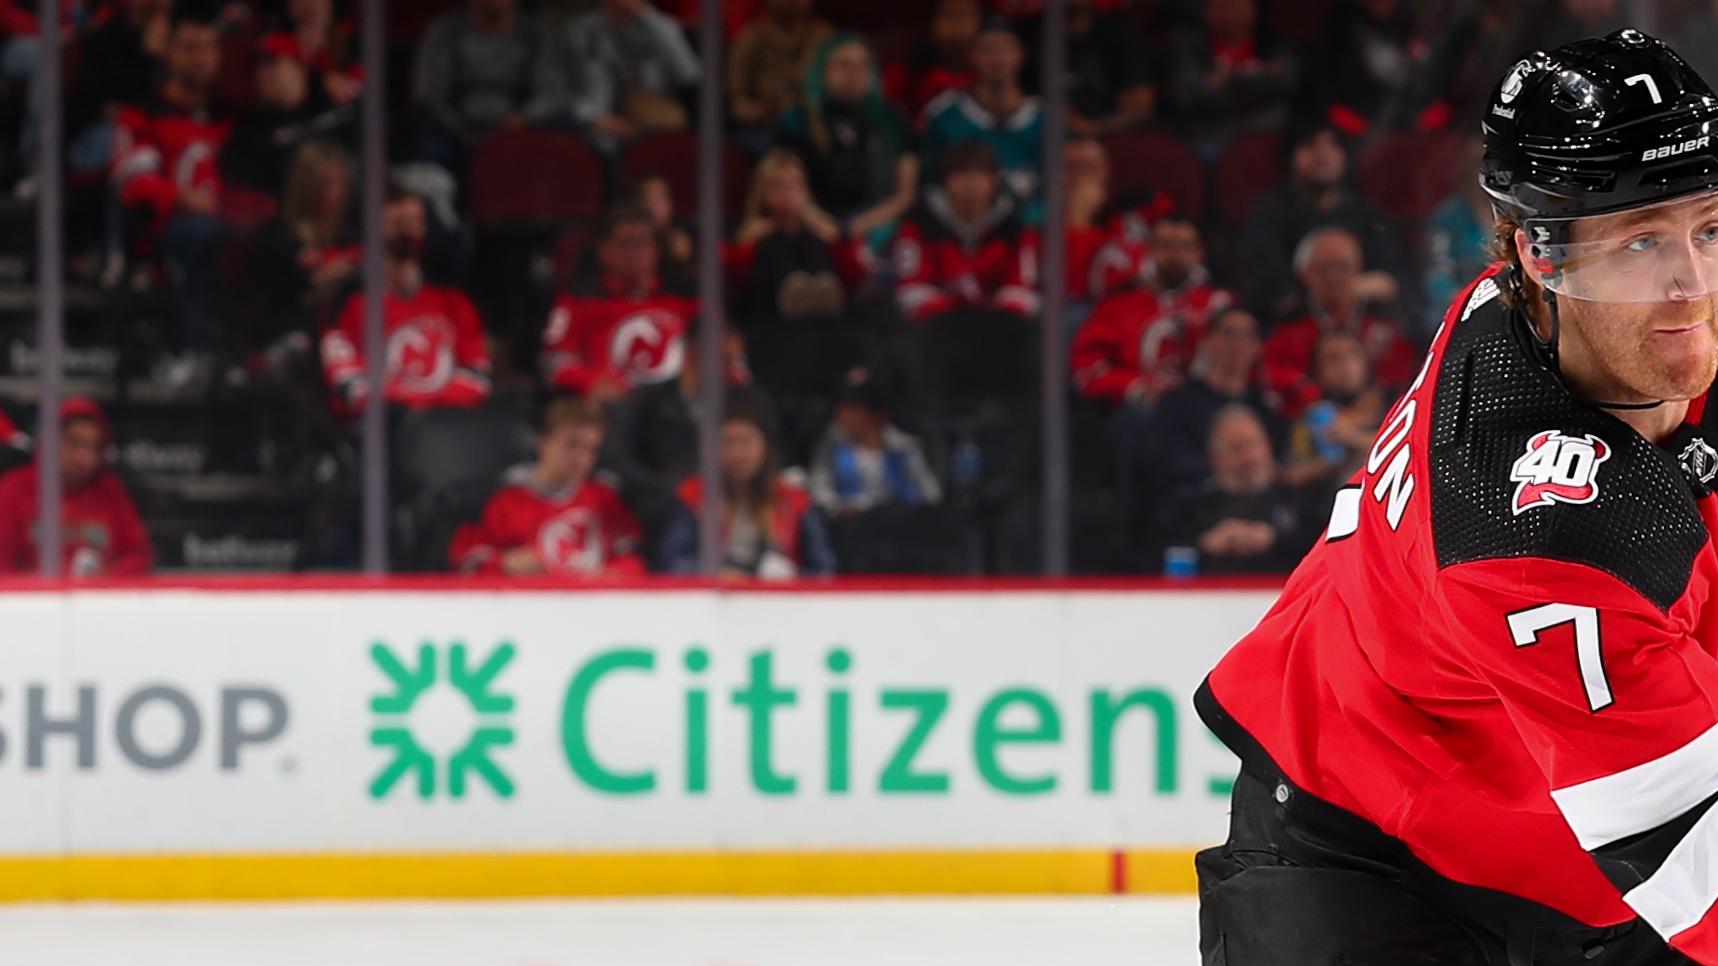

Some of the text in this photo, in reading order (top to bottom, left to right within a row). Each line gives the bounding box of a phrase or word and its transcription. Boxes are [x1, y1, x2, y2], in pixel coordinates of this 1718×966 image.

[1623, 73, 1663, 105] 7
[1641, 136, 1711, 163] BAUER
[1514, 437, 1600, 489] 40
[1507, 602, 1613, 711] 7
[0, 682, 290, 772] HOP
